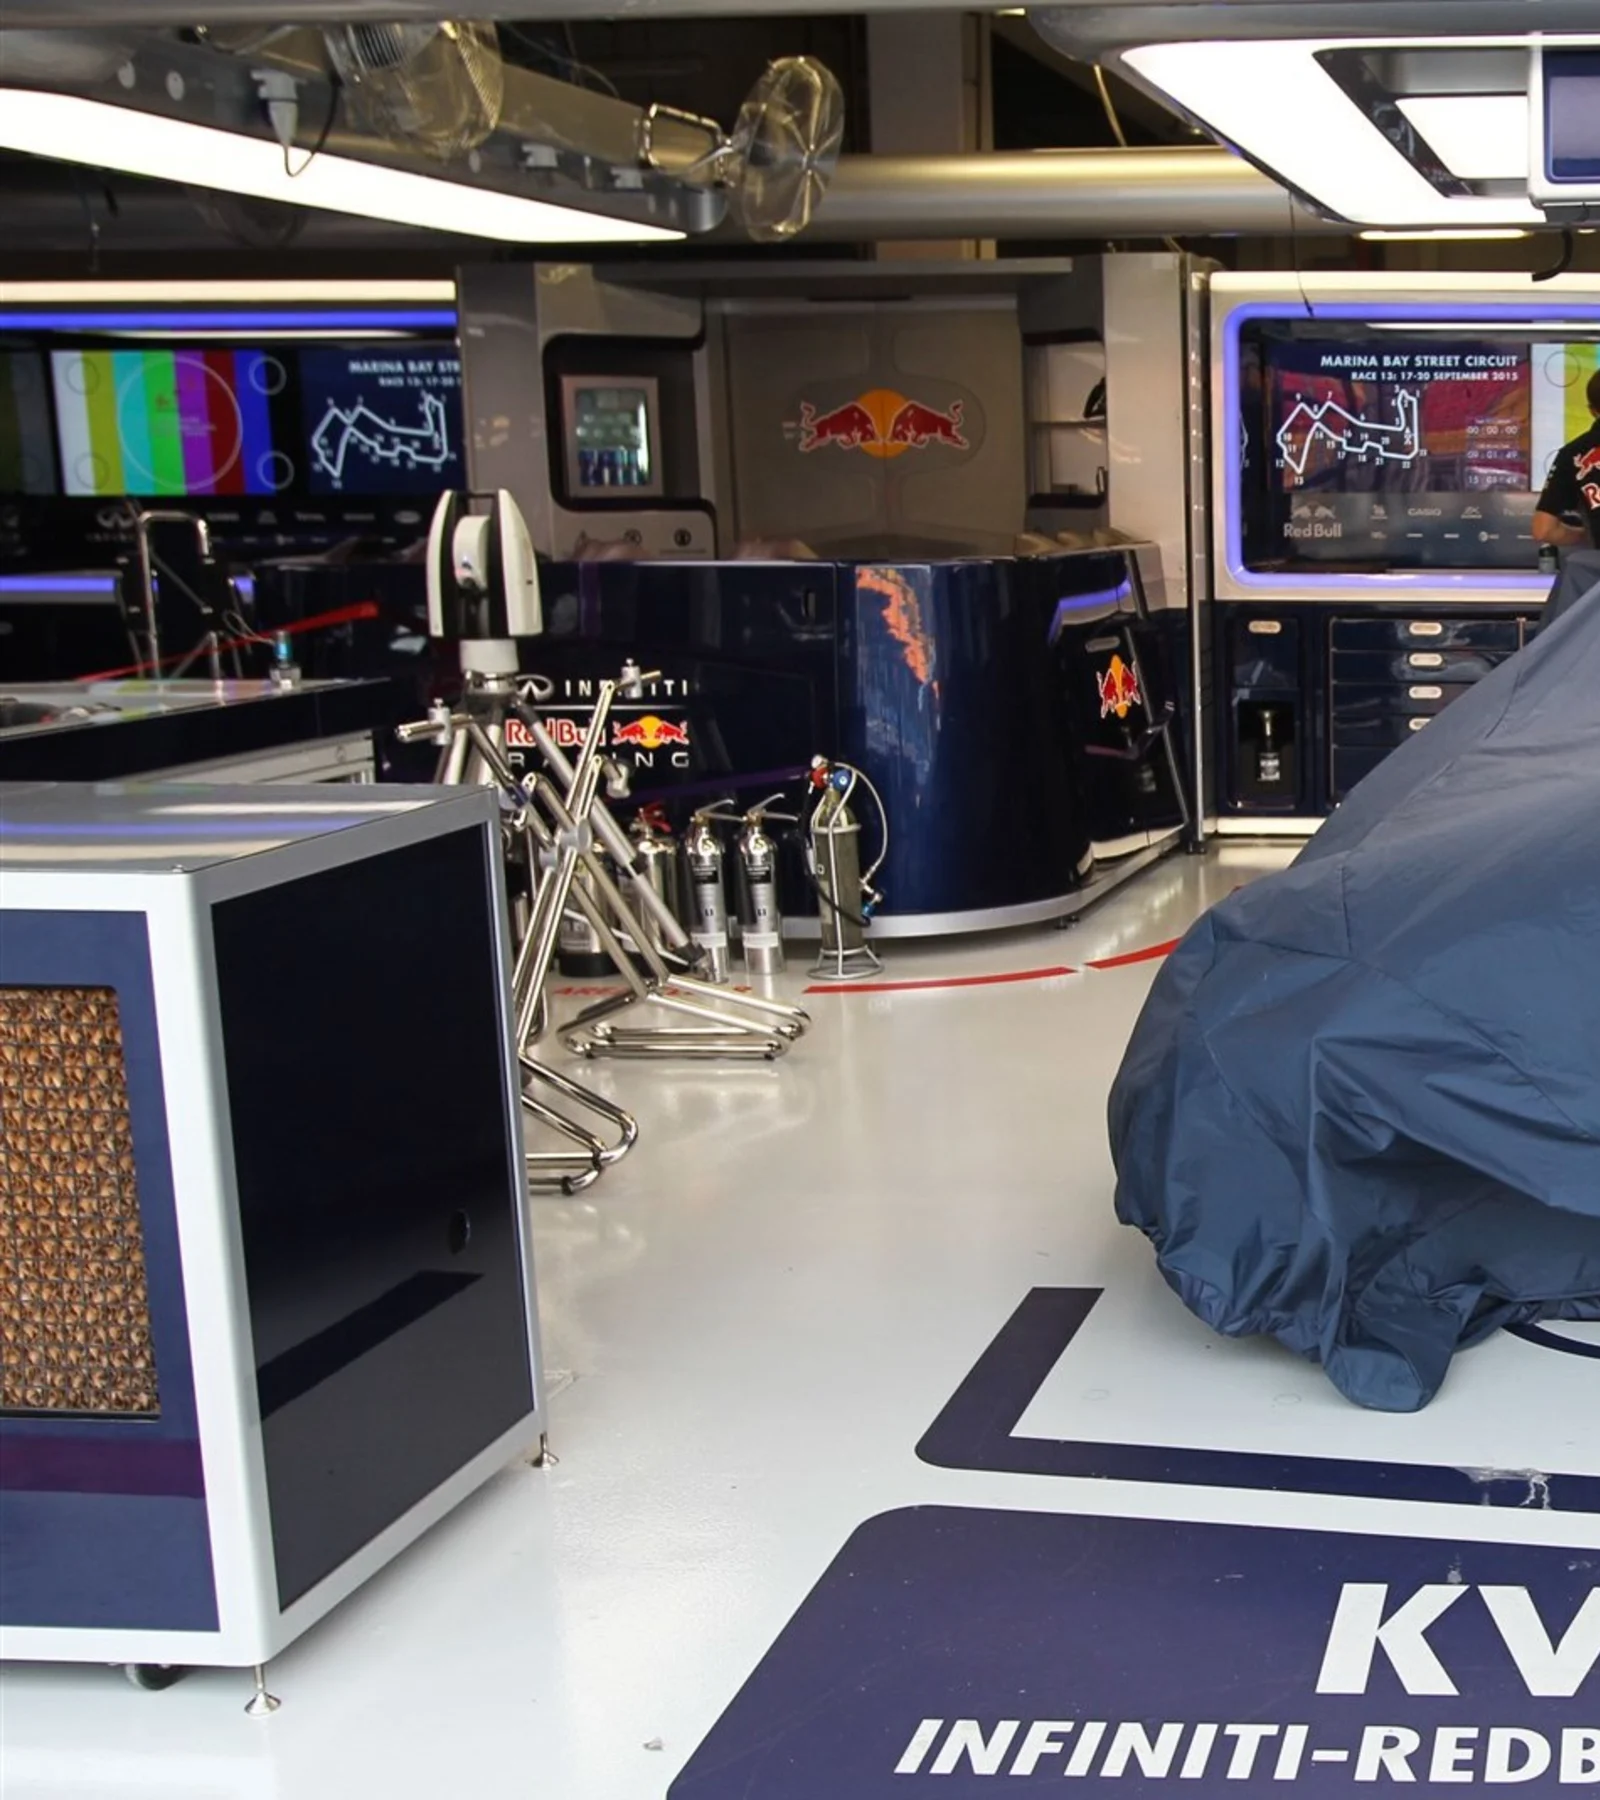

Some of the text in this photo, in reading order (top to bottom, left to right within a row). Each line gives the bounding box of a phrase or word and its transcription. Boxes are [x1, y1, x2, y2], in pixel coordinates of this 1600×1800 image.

[348, 360, 405, 373] MARINA
[407, 360, 434, 373] BAY
[1320, 355, 1518, 367] MARINA BAY STREET CIRCUIT
[1351, 371, 1377, 381] RACE
[1400, 371, 1430, 381] 17-20
[1433, 371, 1489, 381] SEPTEMBER
[1491, 371, 1519, 381] 2015
[1407, 507, 1442, 517] CASIO
